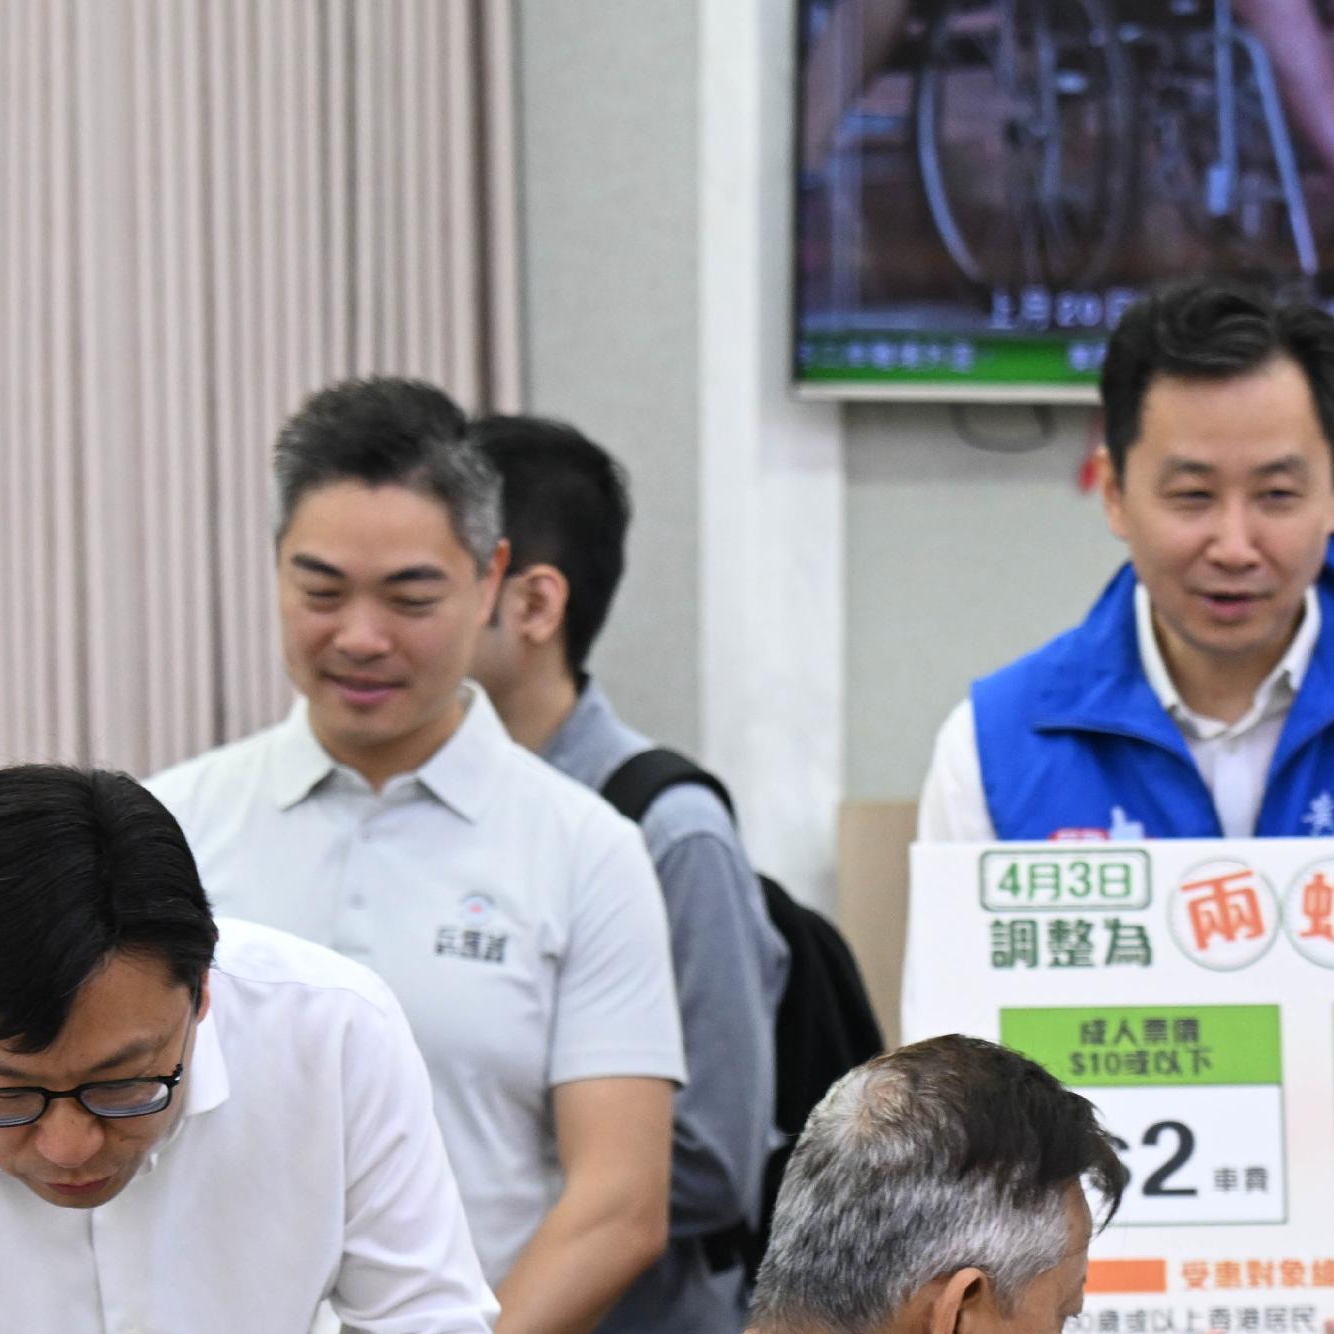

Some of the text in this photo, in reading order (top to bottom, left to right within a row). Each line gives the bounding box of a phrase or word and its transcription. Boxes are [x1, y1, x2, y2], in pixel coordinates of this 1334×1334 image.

[998, 862, 1132, 900] 4月3日
[990, 918, 1153, 969] 調整為
[1079, 1018, 1201, 1046] 成人票價
[1069, 1048, 1213, 1077] $10或以下
[1110, 1120, 1269, 1197] 2 車費
